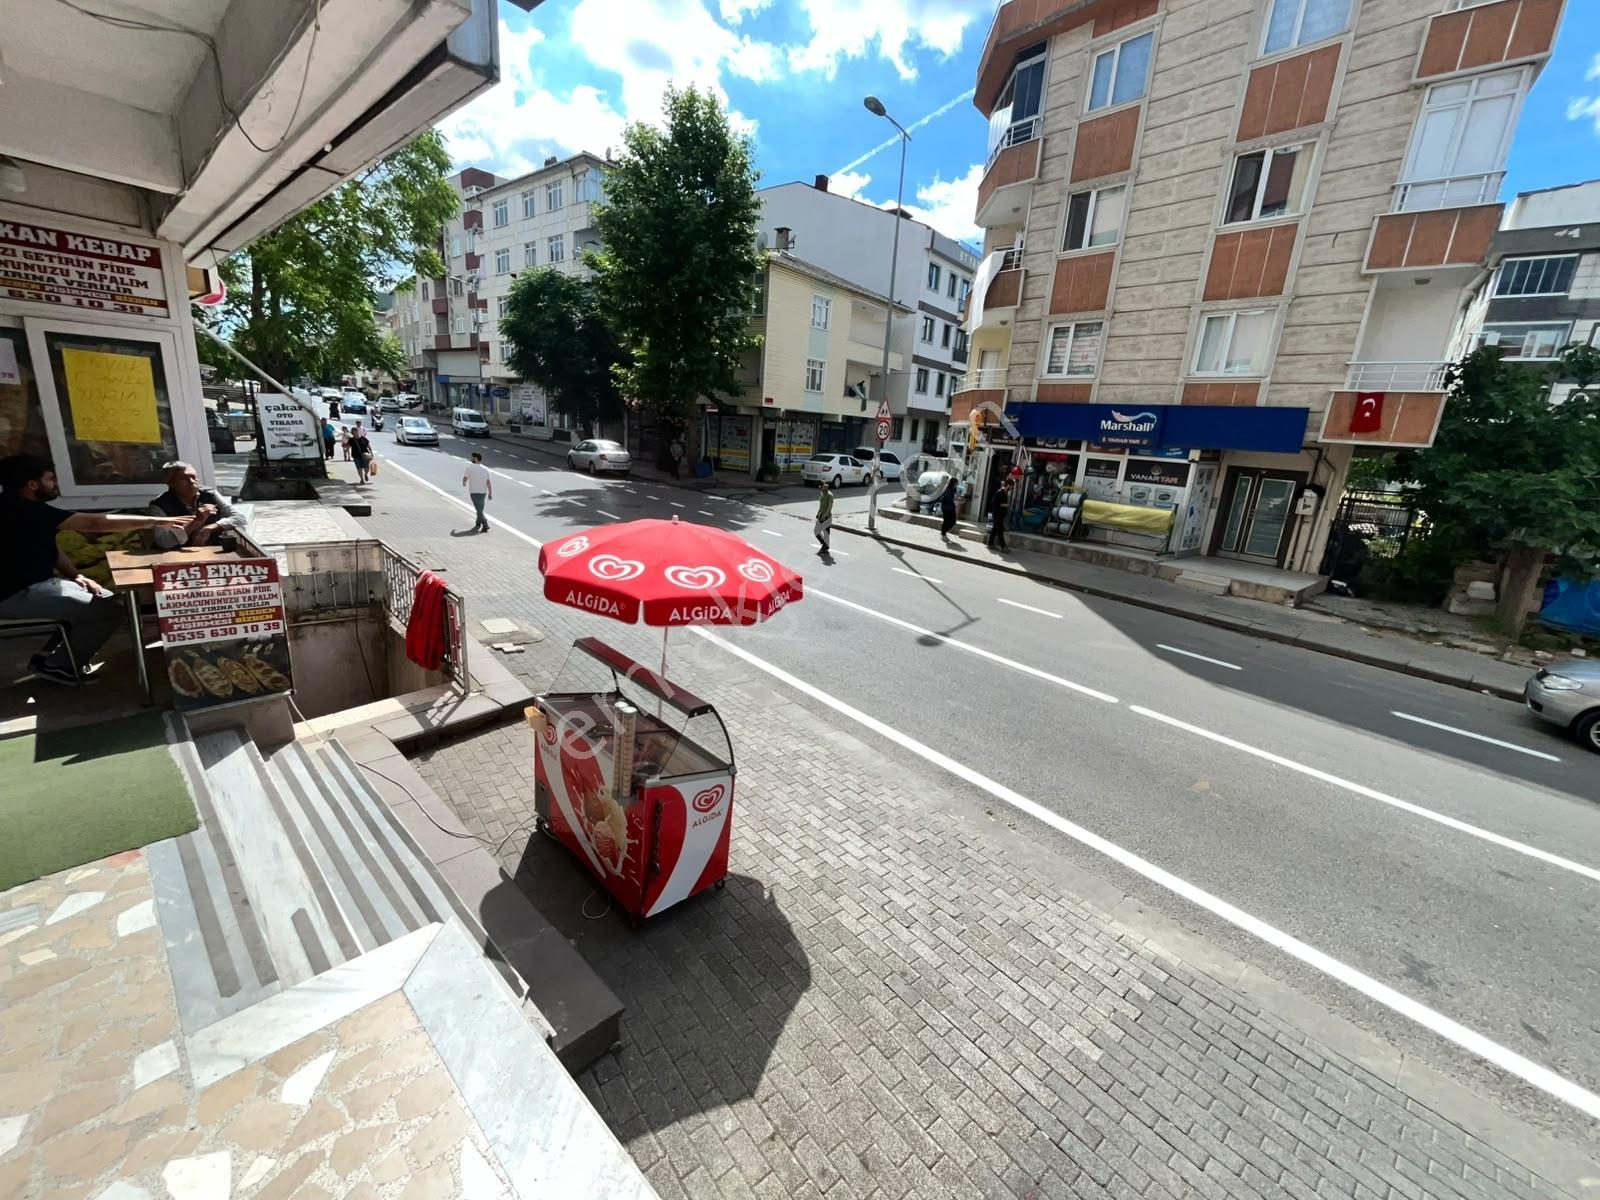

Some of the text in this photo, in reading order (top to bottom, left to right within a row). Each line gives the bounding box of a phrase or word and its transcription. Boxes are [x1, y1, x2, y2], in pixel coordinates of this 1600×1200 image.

[65, 234, 152, 261] KEBAP
[75, 270, 149, 289] YAPALIM
[72, 297, 104, 308] 10
[113, 303, 144, 313] 39
[879, 425, 889, 435] 20
[1101, 420, 1154, 432] Marshall
[1130, 473, 1160, 482] VANAR
[206, 564, 269, 578] ERKAN
[162, 575, 268, 590] KEBAP
[242, 593, 279, 602] YAPALIM
[167, 621, 280, 642] 0535 630 10 39
